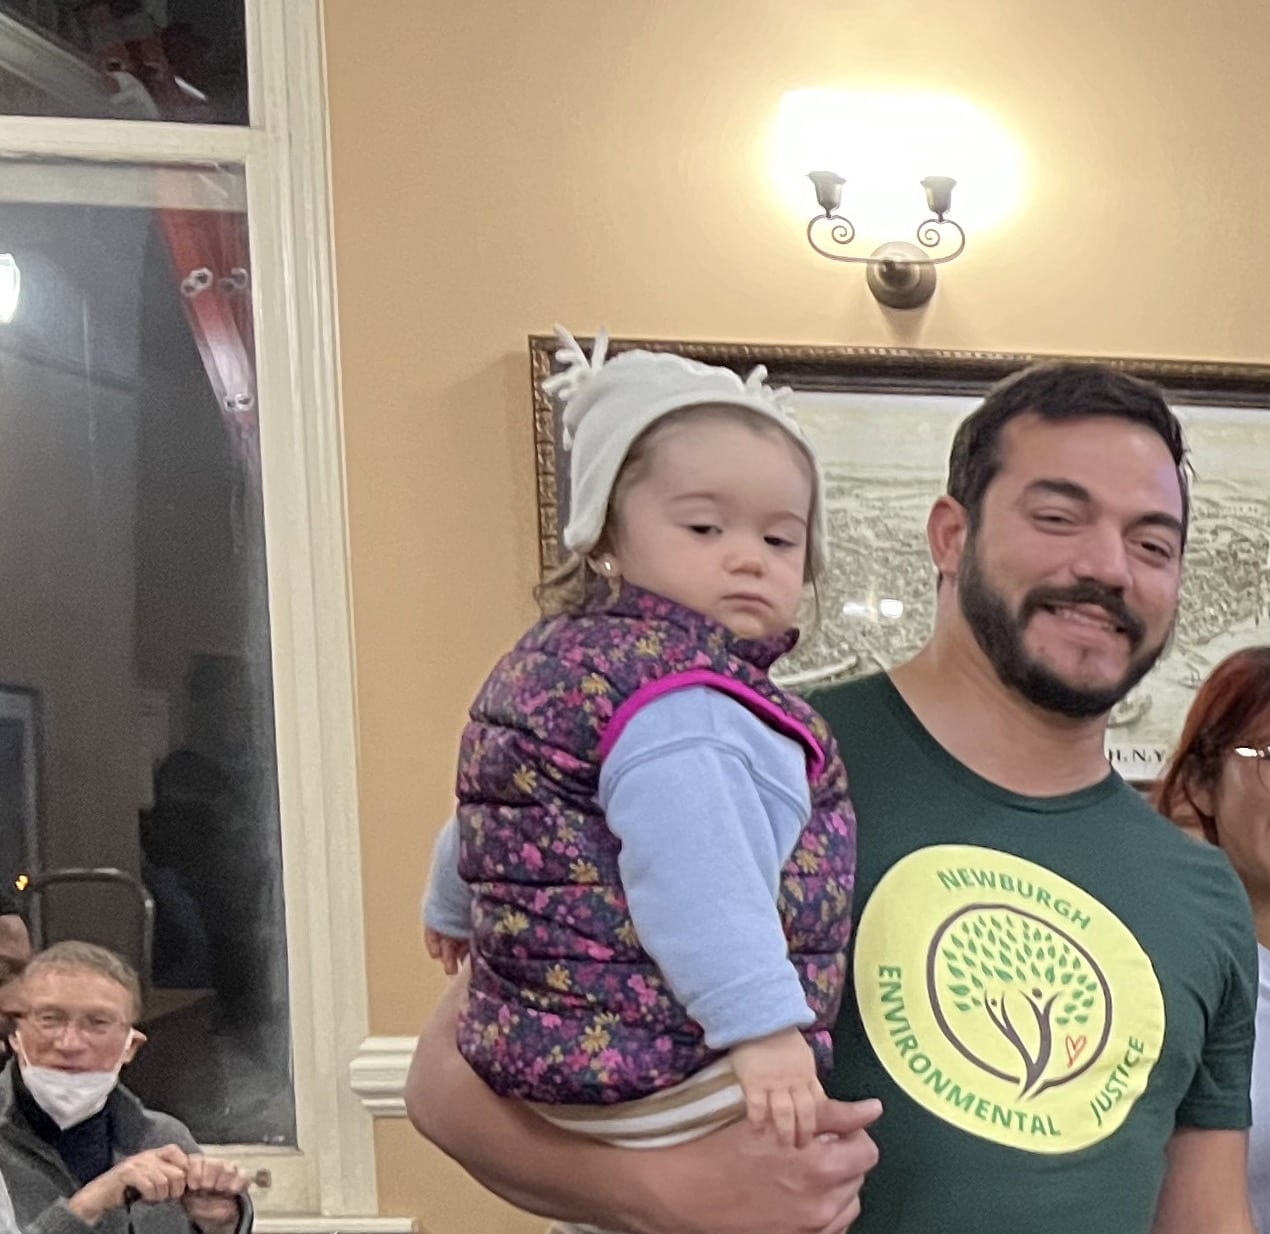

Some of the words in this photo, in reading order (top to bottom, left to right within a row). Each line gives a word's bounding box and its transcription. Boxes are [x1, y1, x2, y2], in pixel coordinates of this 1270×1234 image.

[936, 868, 1091, 930] NEWBURGH
[878, 964, 1062, 1137] ENVIRONMENTAL
[1089, 1037, 1146, 1126] JUSTICE
